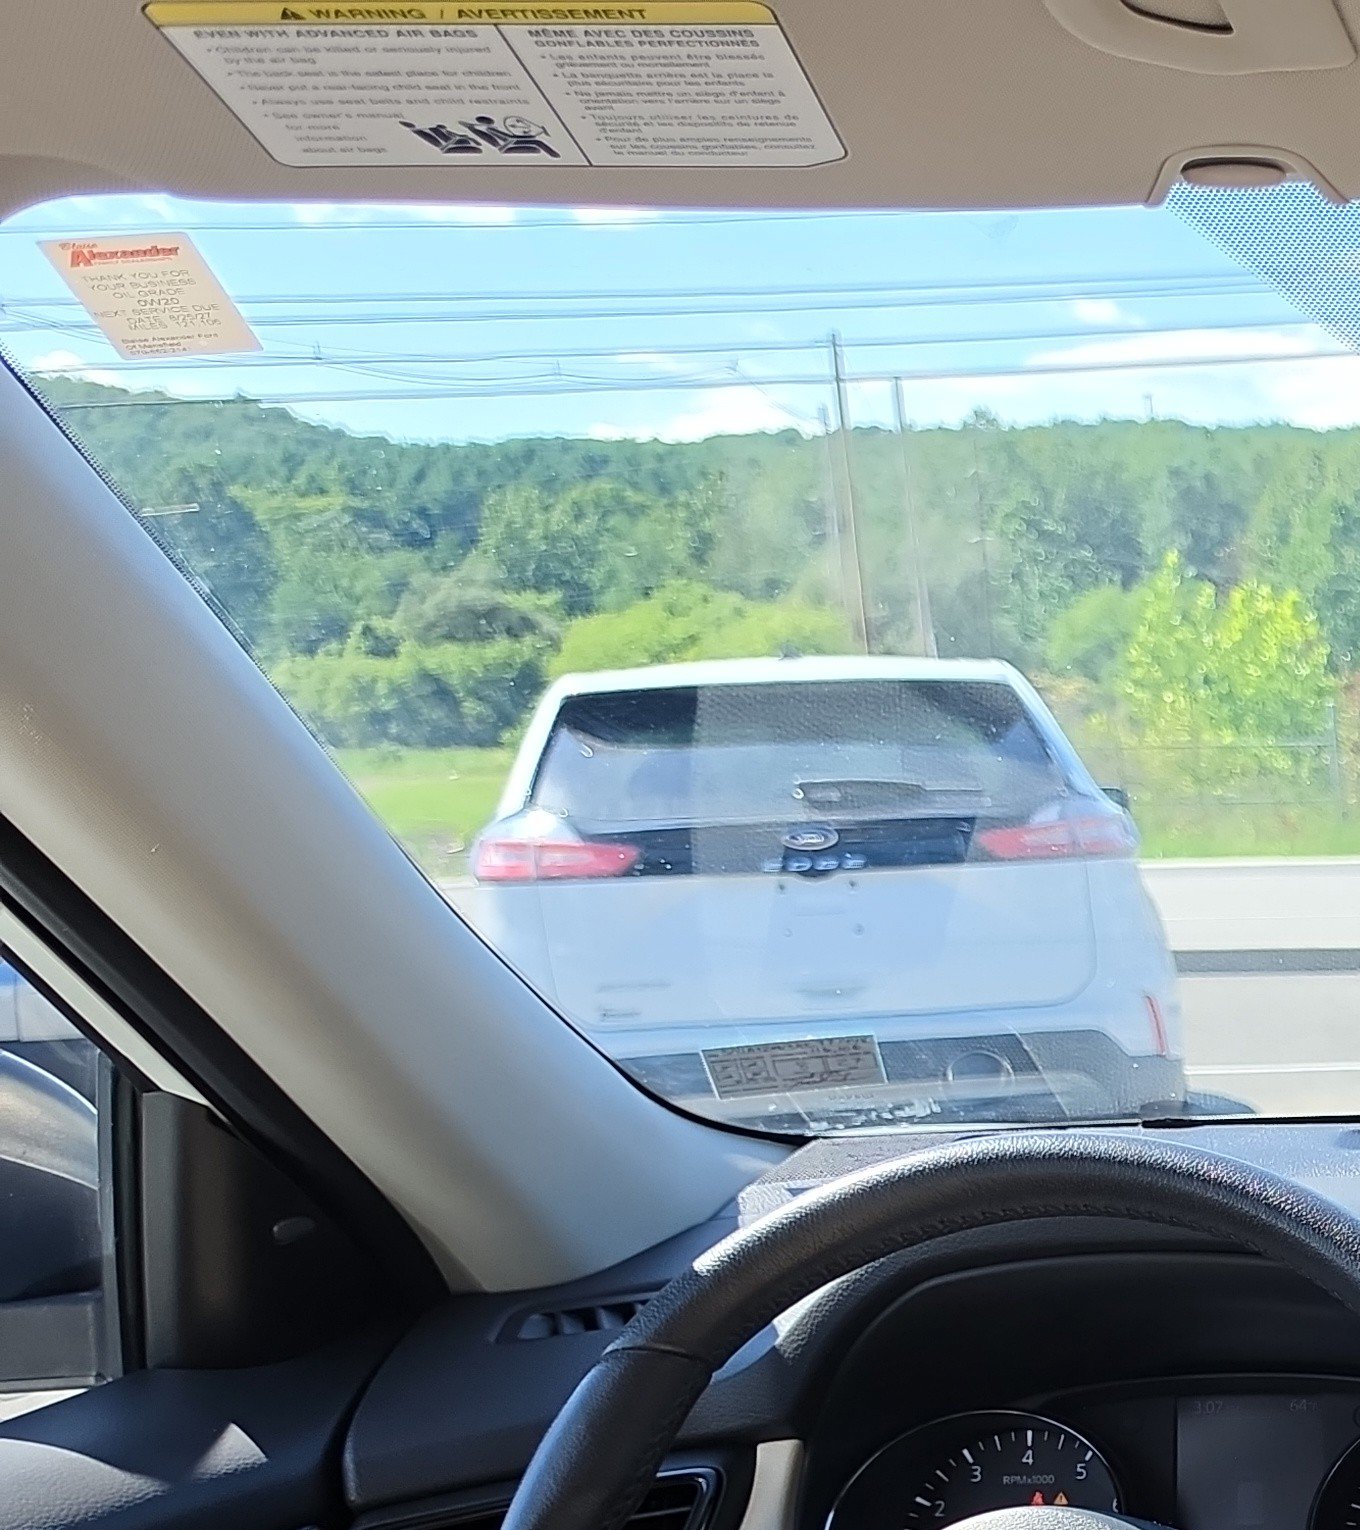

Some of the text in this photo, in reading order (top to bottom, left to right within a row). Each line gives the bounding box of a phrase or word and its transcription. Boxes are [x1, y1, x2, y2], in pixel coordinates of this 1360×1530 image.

[309, 9, 426, 19] WARNING
[457, 9, 647, 19] AVERTISSEMENT
[193, 29, 479, 38] EVEN WITH ADVANCED AIR BAGS
[583, 29, 626, 38] AVEC
[630, 29, 665, 38] DES
[669, 29, 755, 38] COUSSINS
[70, 245, 180, 268] Alexander
[81, 269, 190, 283] THANK YOU FOR
[90, 278, 197, 292] YOUR BUSINESS
[112, 288, 185, 299] OIL GRADE
[94, 303, 220, 318] NEXT SERVICE DUE
[127, 316, 160, 325] DATE
[128, 322, 168, 331] MILES
[1021, 1449, 1034, 1466] 4
[970, 1465, 982, 1483] 3
[1075, 1462, 1087, 1480] 5
[932, 1499, 945, 1517] 2
